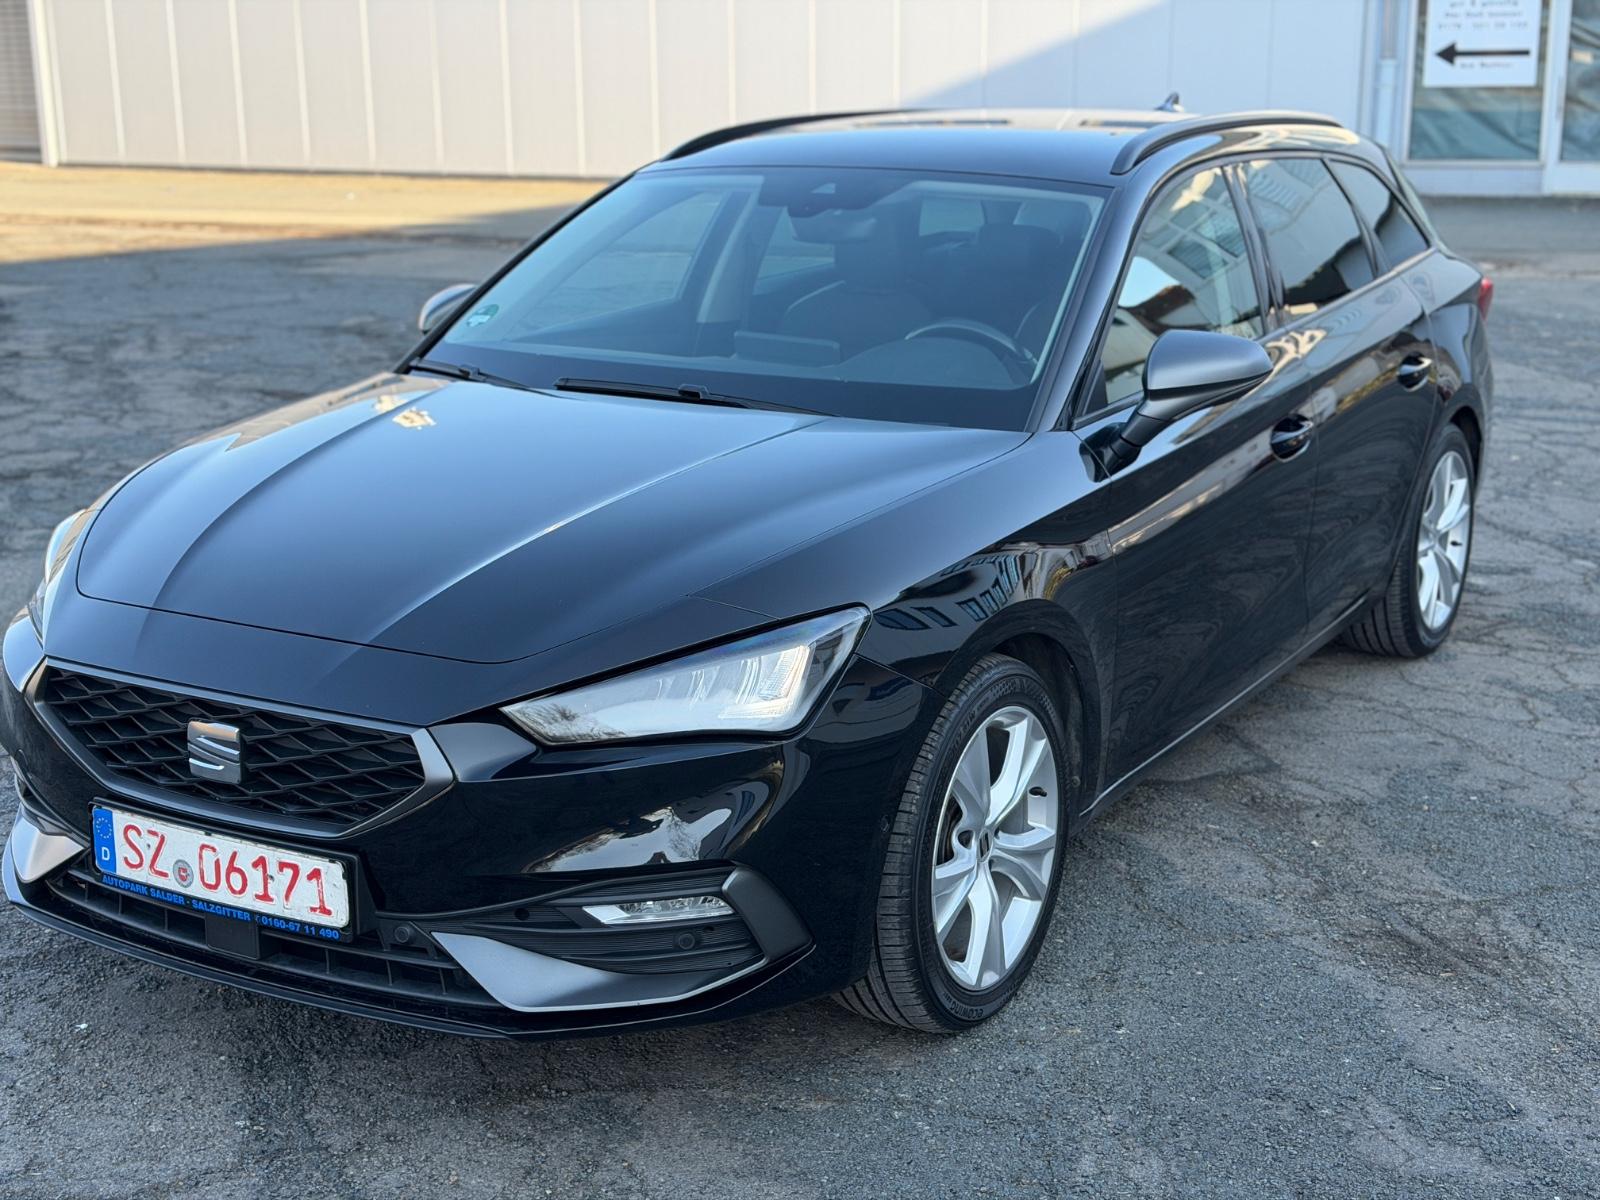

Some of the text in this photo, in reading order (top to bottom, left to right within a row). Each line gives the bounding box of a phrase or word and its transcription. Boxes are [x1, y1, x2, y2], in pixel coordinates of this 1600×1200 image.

[101, 846, 111, 861] D
[123, 824, 333, 916] SZ 06171
[102, 874, 148, 896] AUTOPARK
[149, 887, 185, 906] SALDER
[191, 899, 251, 921] SALZGITTER
[261, 916, 301, 933] 0160-67
[303, 925, 316, 936] 11
[319, 928, 340, 940] 490
